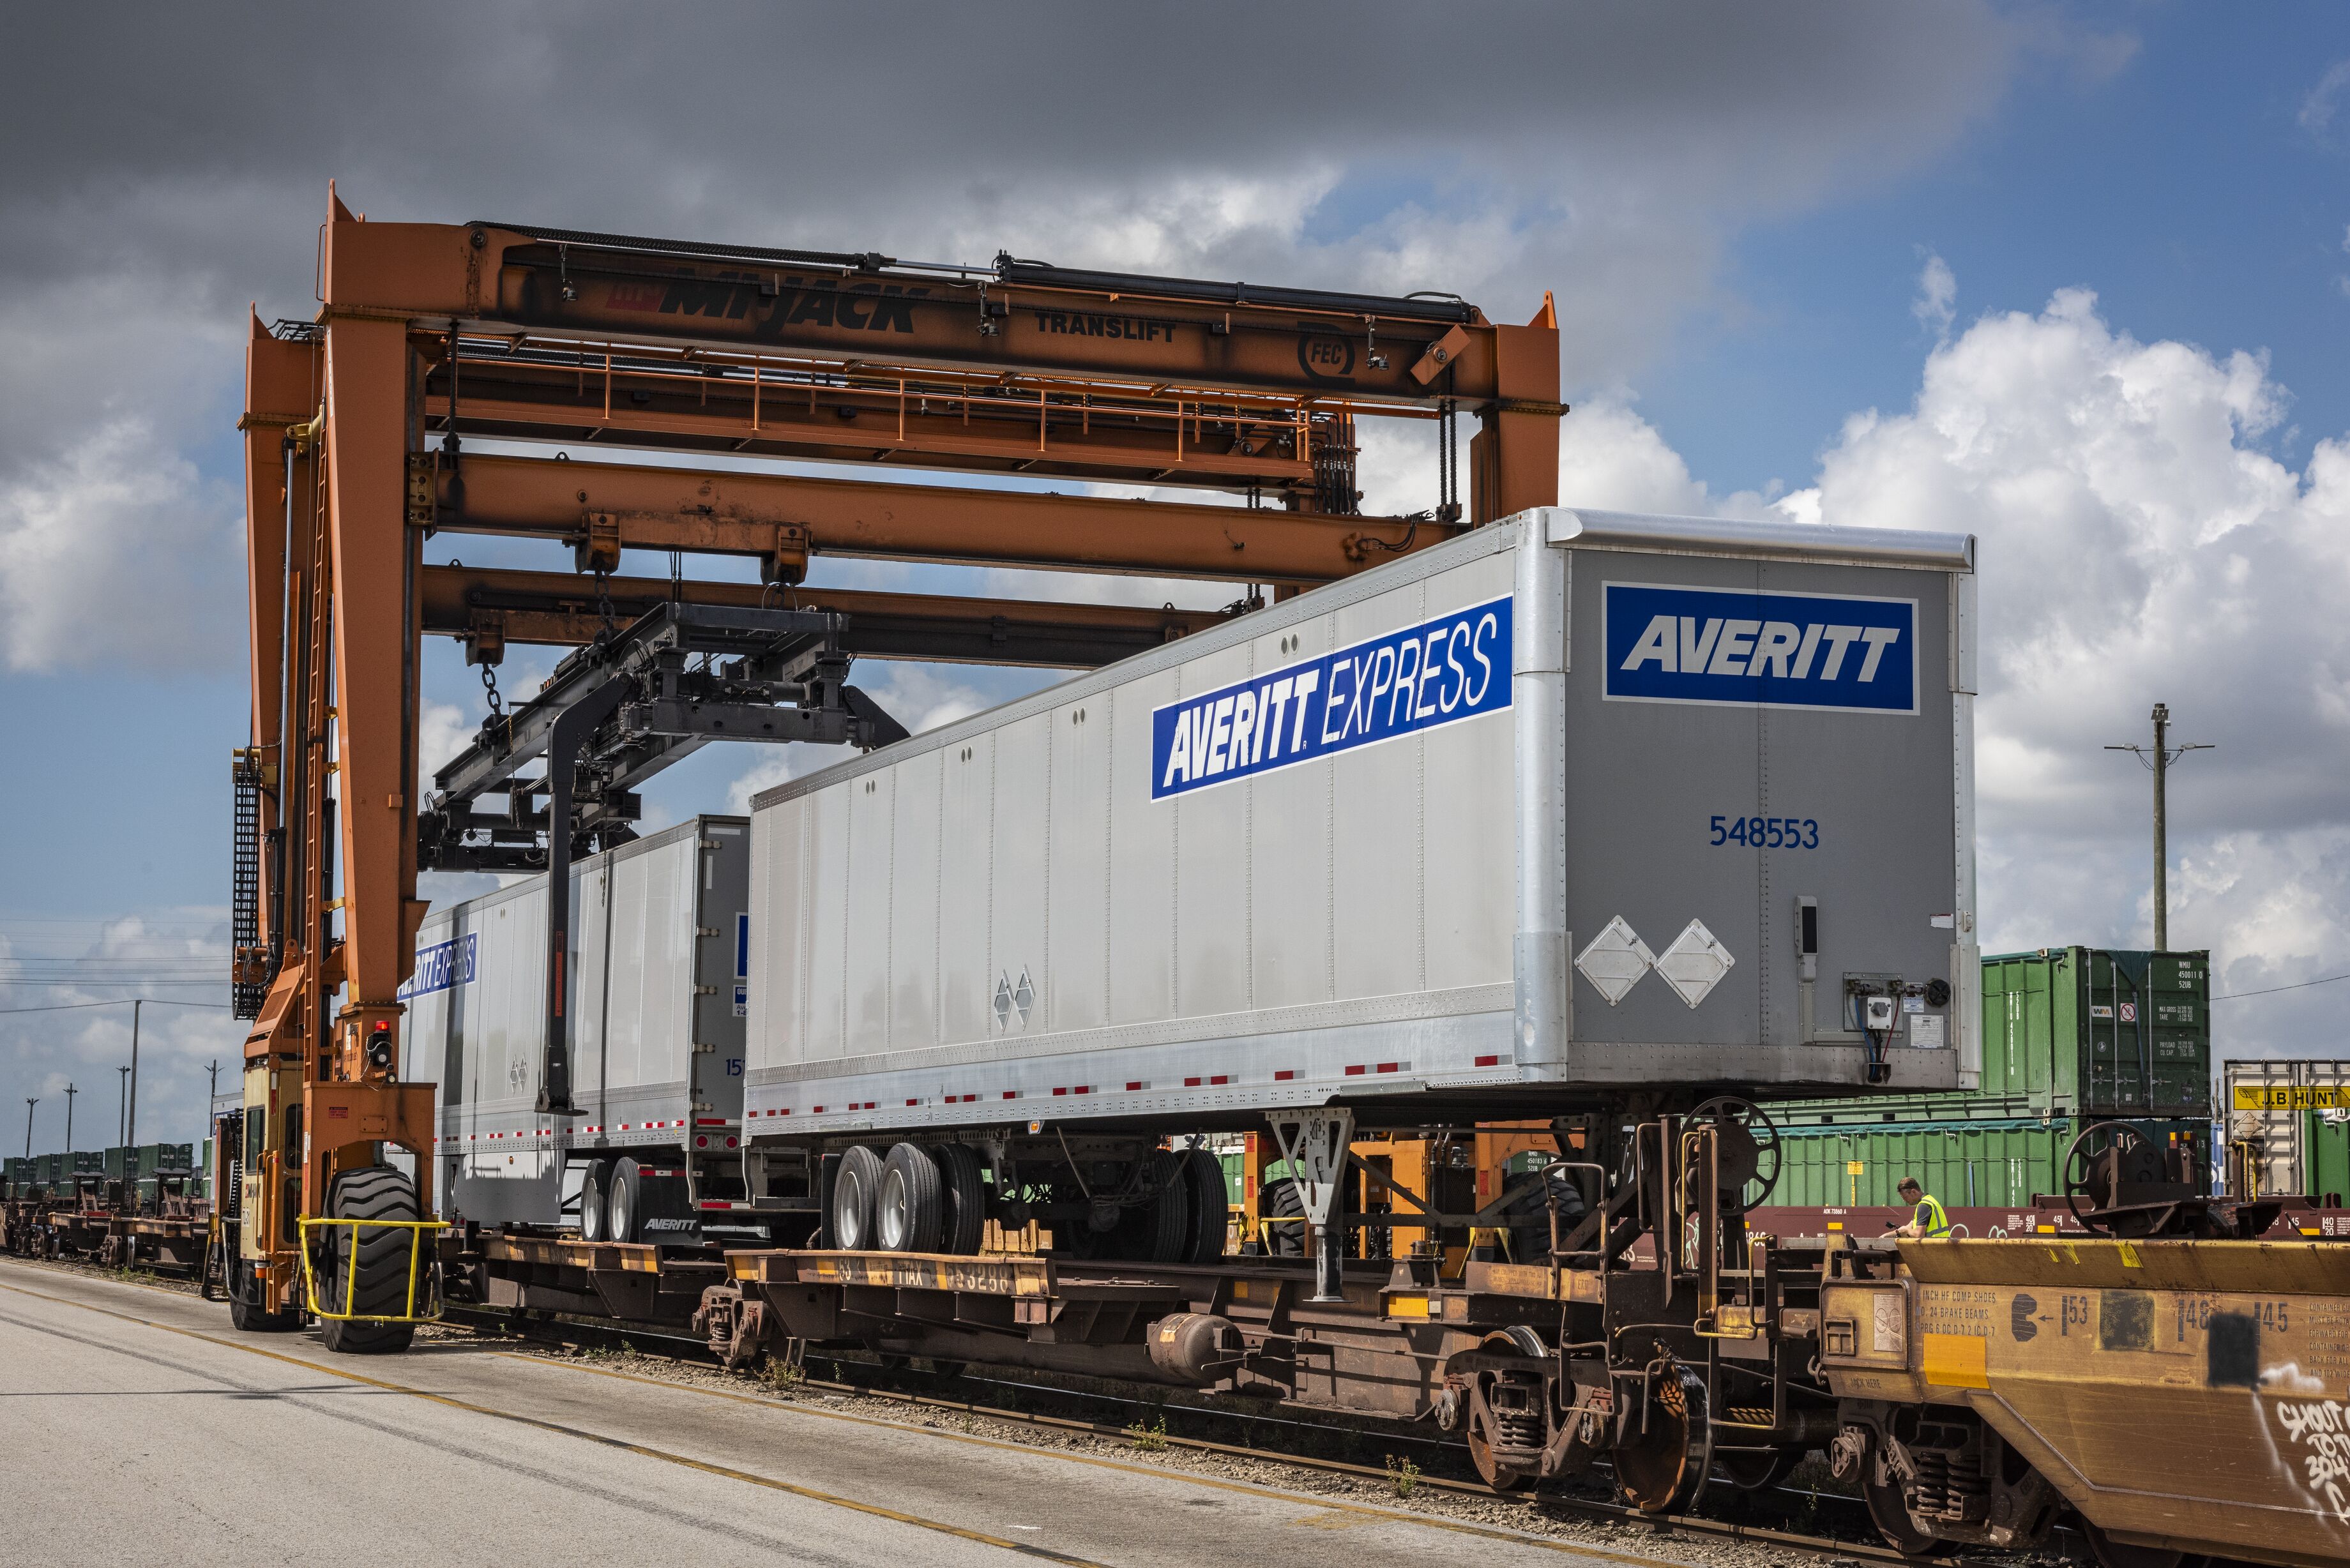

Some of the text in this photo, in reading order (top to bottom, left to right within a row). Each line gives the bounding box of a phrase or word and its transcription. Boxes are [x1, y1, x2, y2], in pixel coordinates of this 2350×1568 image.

[1035, 311, 1176, 343] TRANSLIFT
[1310, 342, 1341, 365] FEC
[1620, 615, 1900, 682] AVERITT
[1163, 668, 1320, 788] AVERITT
[1321, 612, 1497, 745] EXPRESS
[1709, 816, 1819, 849] 548553
[397, 938, 474, 997] RITT EXPRESS
[2178, 970, 2196, 979] 450011
[2262, 1092, 2337, 1105] J.B. HUNT
[644, 1218, 697, 1230] AVERITT
[2053, 1215, 2060, 1223] 45
[2272, 1217, 2279, 1225] 8
[2291, 1217, 2299, 1226] 45
[2324, 1217, 2334, 1226] 40
[2026, 1224, 2033, 1232] 20
[2325, 1228, 2334, 1236] 20
[898, 1260, 923, 1286] TTAX
[1923, 1290, 1939, 1300] INCH
[1941, 1290, 1950, 1301] HF
[1952, 1291, 1971, 1302] COMP
[1974, 1292, 1996, 1303] SHOES
[1930, 1306, 1937, 1316] 24
[1940, 1308, 1962, 1318] BRAKE
[1965, 1308, 1988, 1320] BEAMS
[2069, 1296, 2088, 1324] 53
[2309, 1303, 2340, 1312] CONTAINER
[2186, 1300, 2210, 1330] 48
[2263, 1302, 2288, 1332] 45
[1936, 1323, 1939, 1334] 6
[1967, 1325, 1971, 1336] 2
[2309, 1329, 2349, 1338] FORWARD FOR
[2309, 1343, 2349, 1352] CONTAINER OR
[2309, 1355, 2324, 1364] BACK
[2326, 1356, 2337, 1364] FOR
[2310, 1369, 2322, 1377] AND
[2335, 1370, 2350, 1378] WIDE
[1851, 1378, 1881, 1389] JACK HERE
[2306, 1433, 2337, 1458] TO
